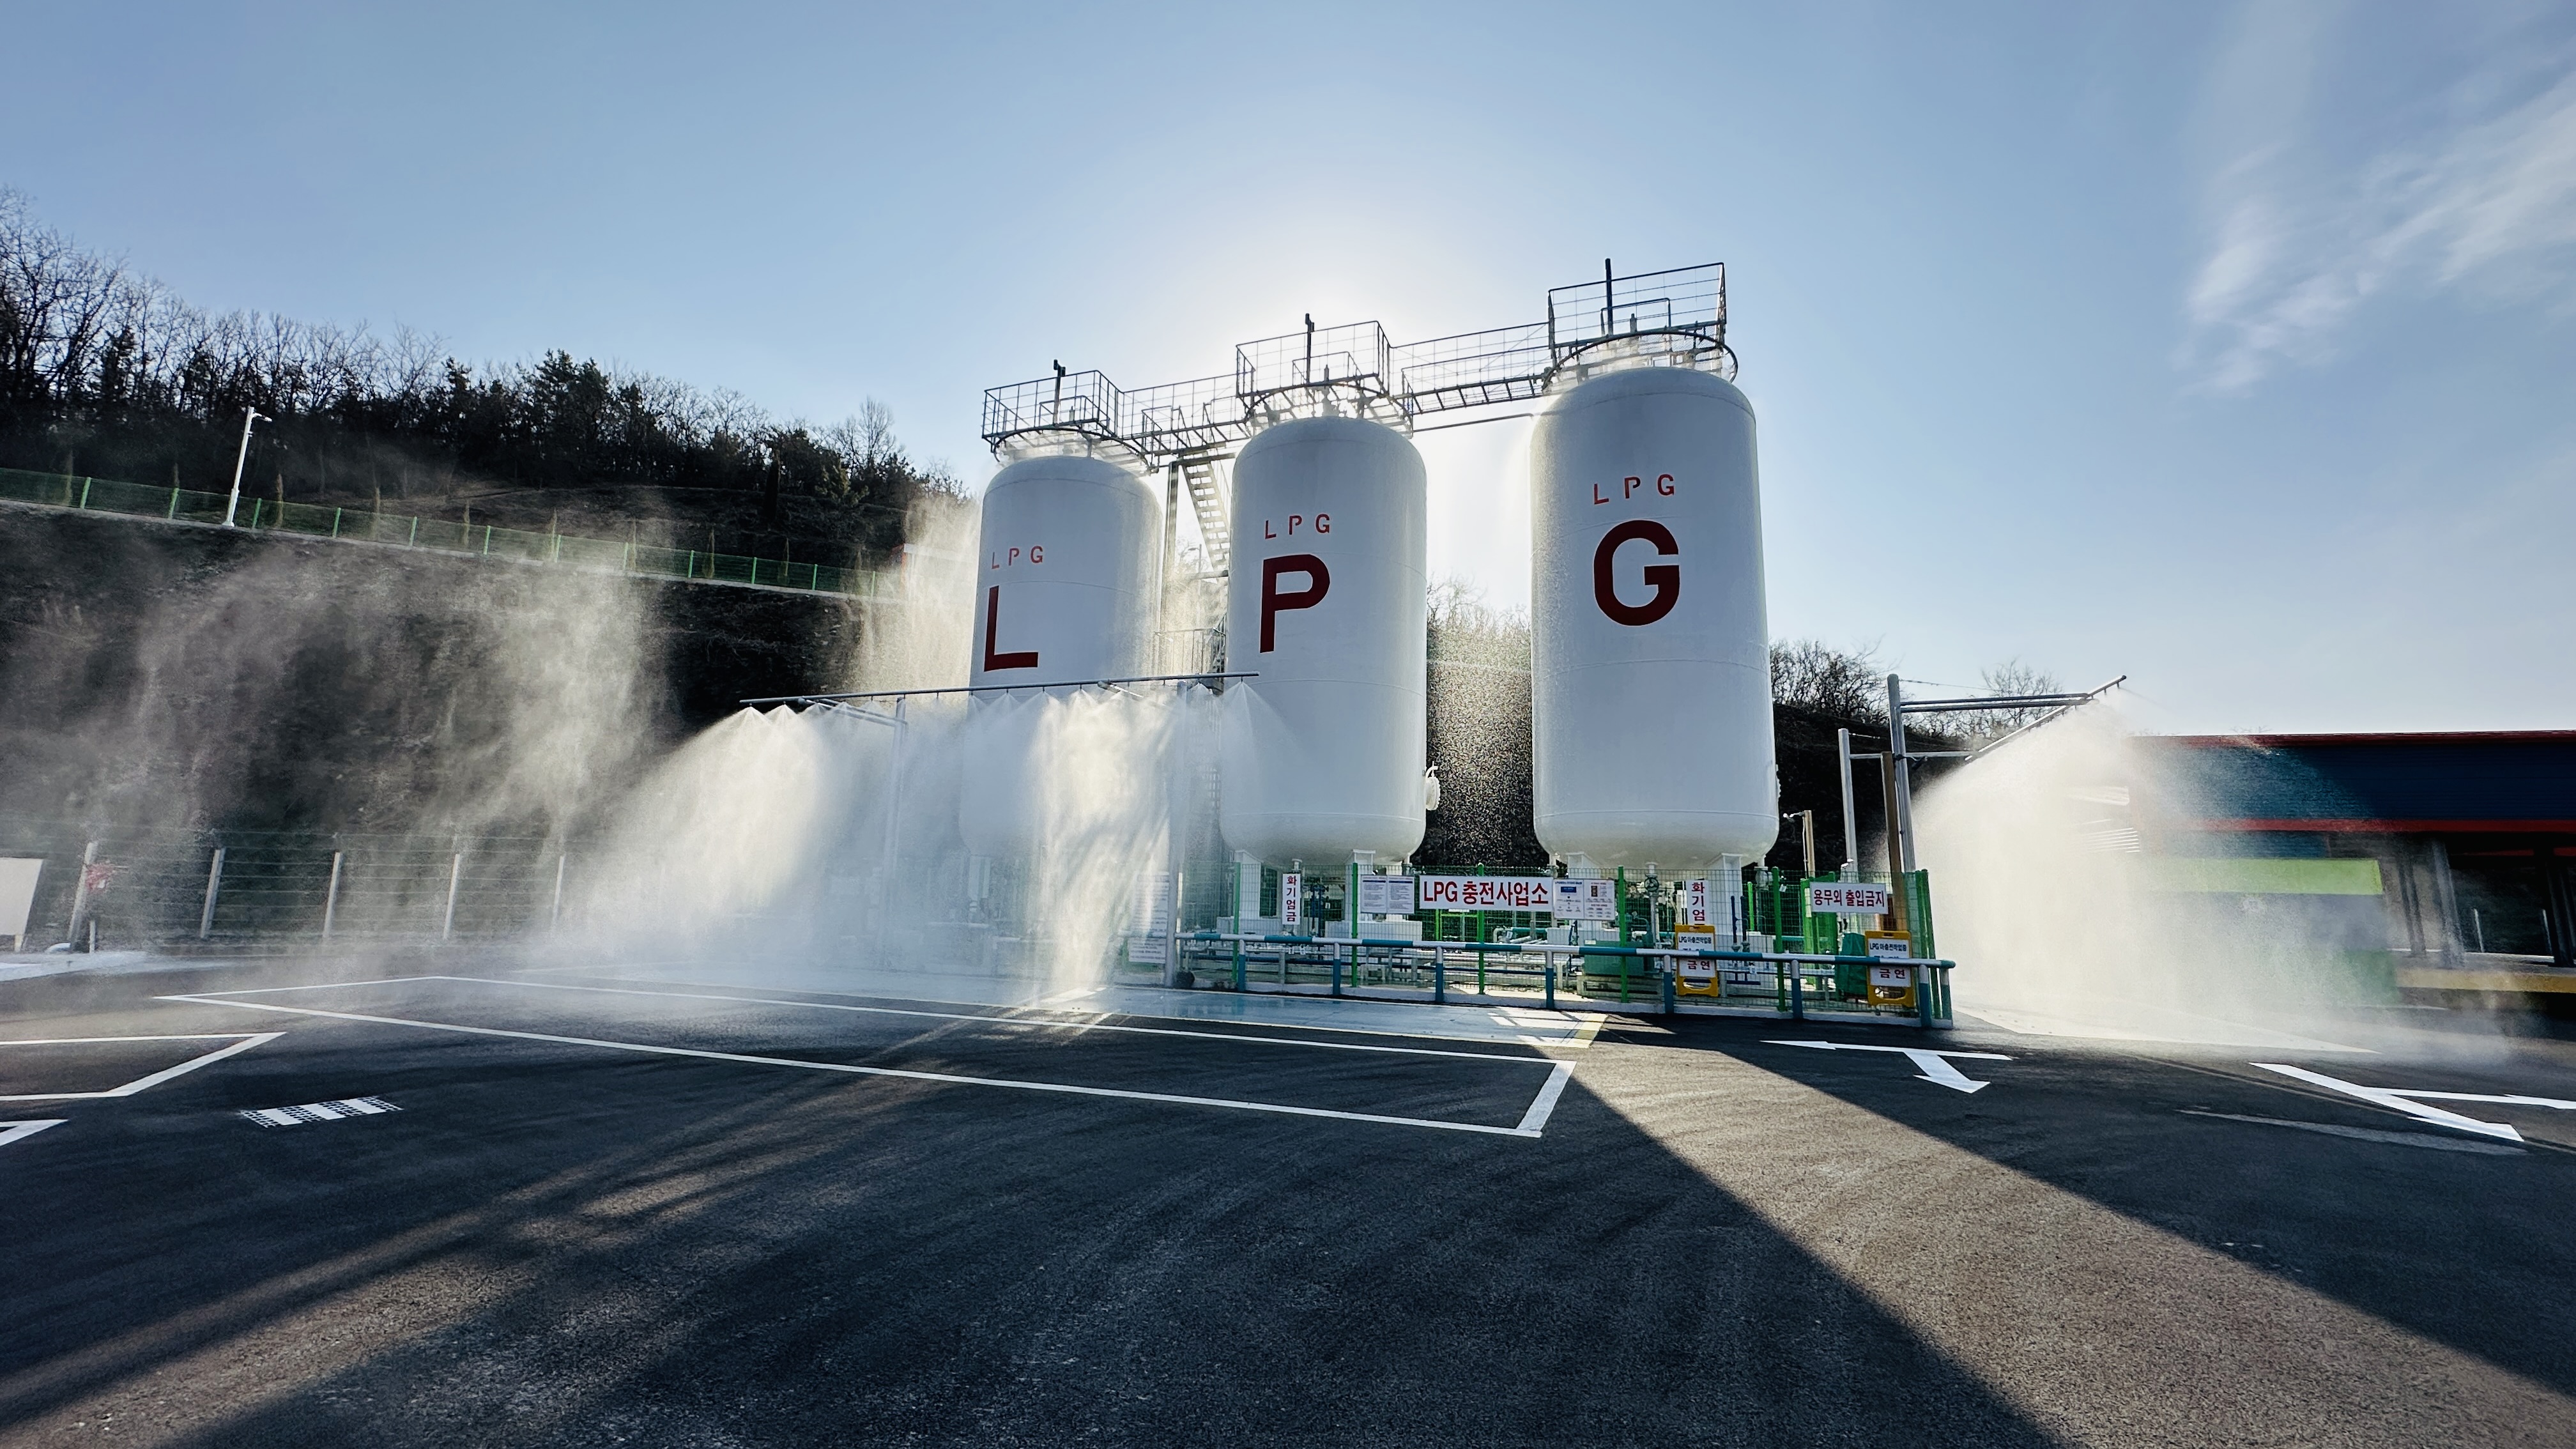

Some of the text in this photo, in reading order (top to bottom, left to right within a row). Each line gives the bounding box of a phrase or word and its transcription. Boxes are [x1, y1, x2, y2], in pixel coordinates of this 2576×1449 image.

[1259, 553, 1331, 654] P
[1593, 519, 1680, 626] G
[983, 585, 1039, 672] L
[1423, 880, 1458, 902] LPG
[1462, 880, 1549, 907] 충전사업소
[1691, 882, 1705, 925] 화기엄
[1813, 889, 1885, 908] 용무외 출입금지
